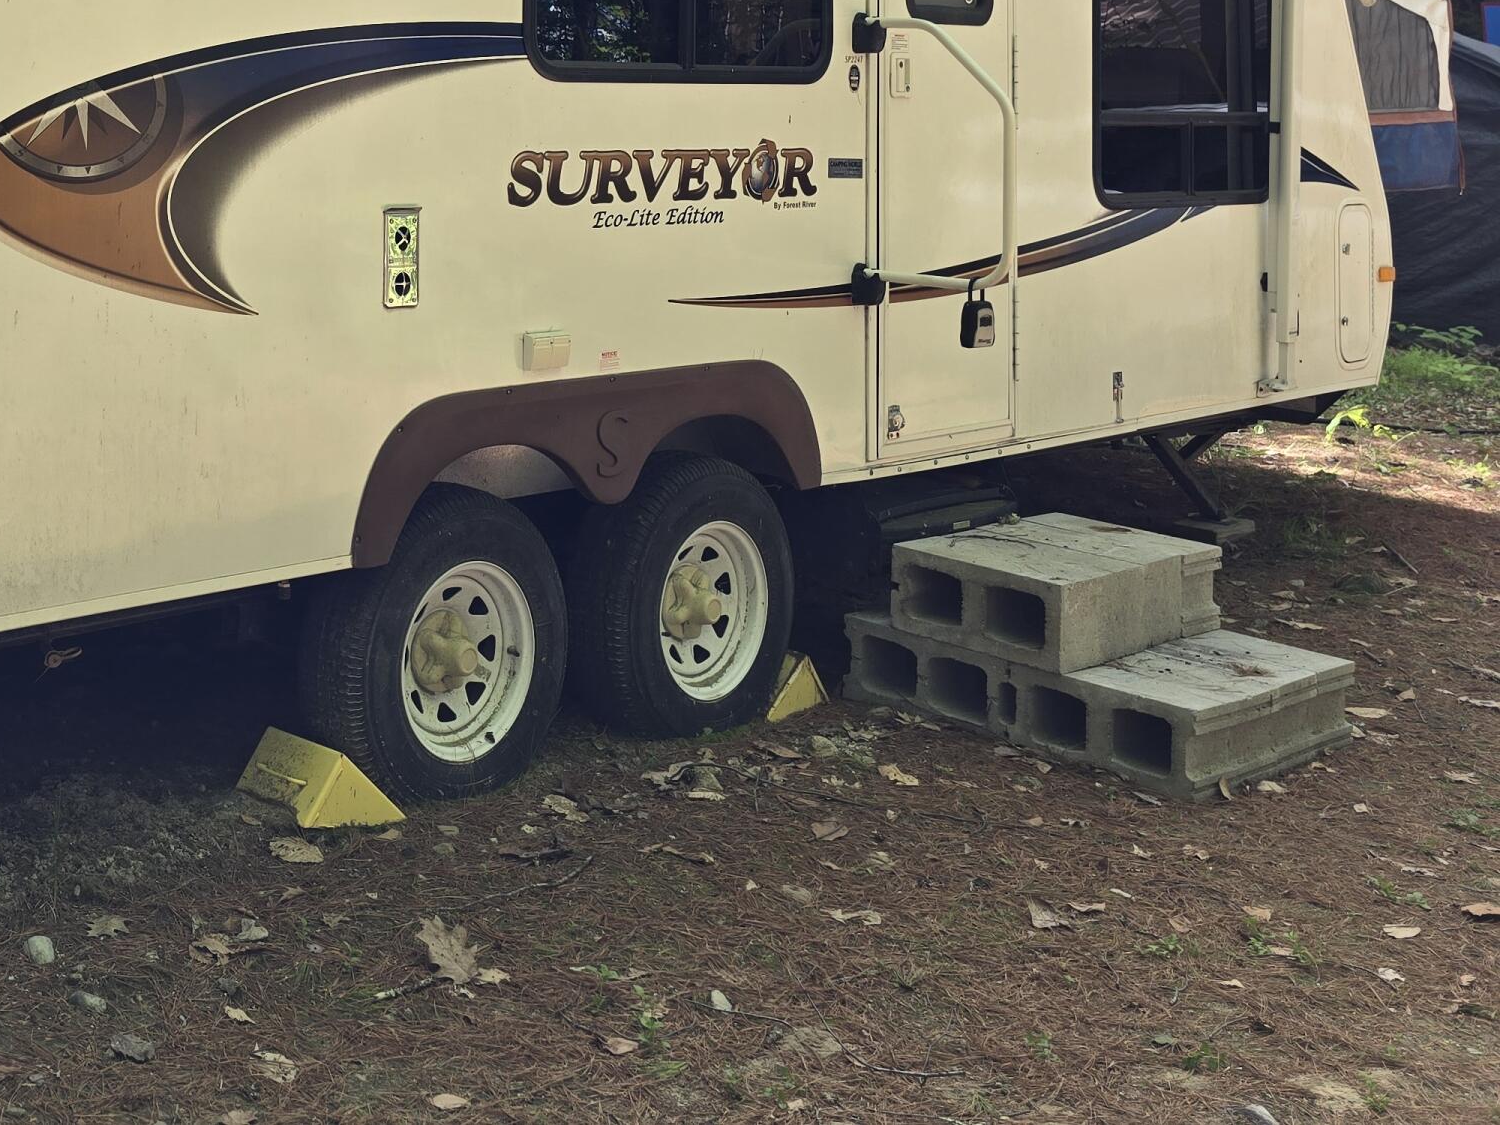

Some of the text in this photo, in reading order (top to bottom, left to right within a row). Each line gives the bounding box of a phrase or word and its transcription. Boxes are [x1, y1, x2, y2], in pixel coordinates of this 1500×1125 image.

[507, 139, 818, 207] SURVEYOR
[592, 205, 725, 229] Eco-Lite Edition
[773, 200, 817, 211] By Forest River
